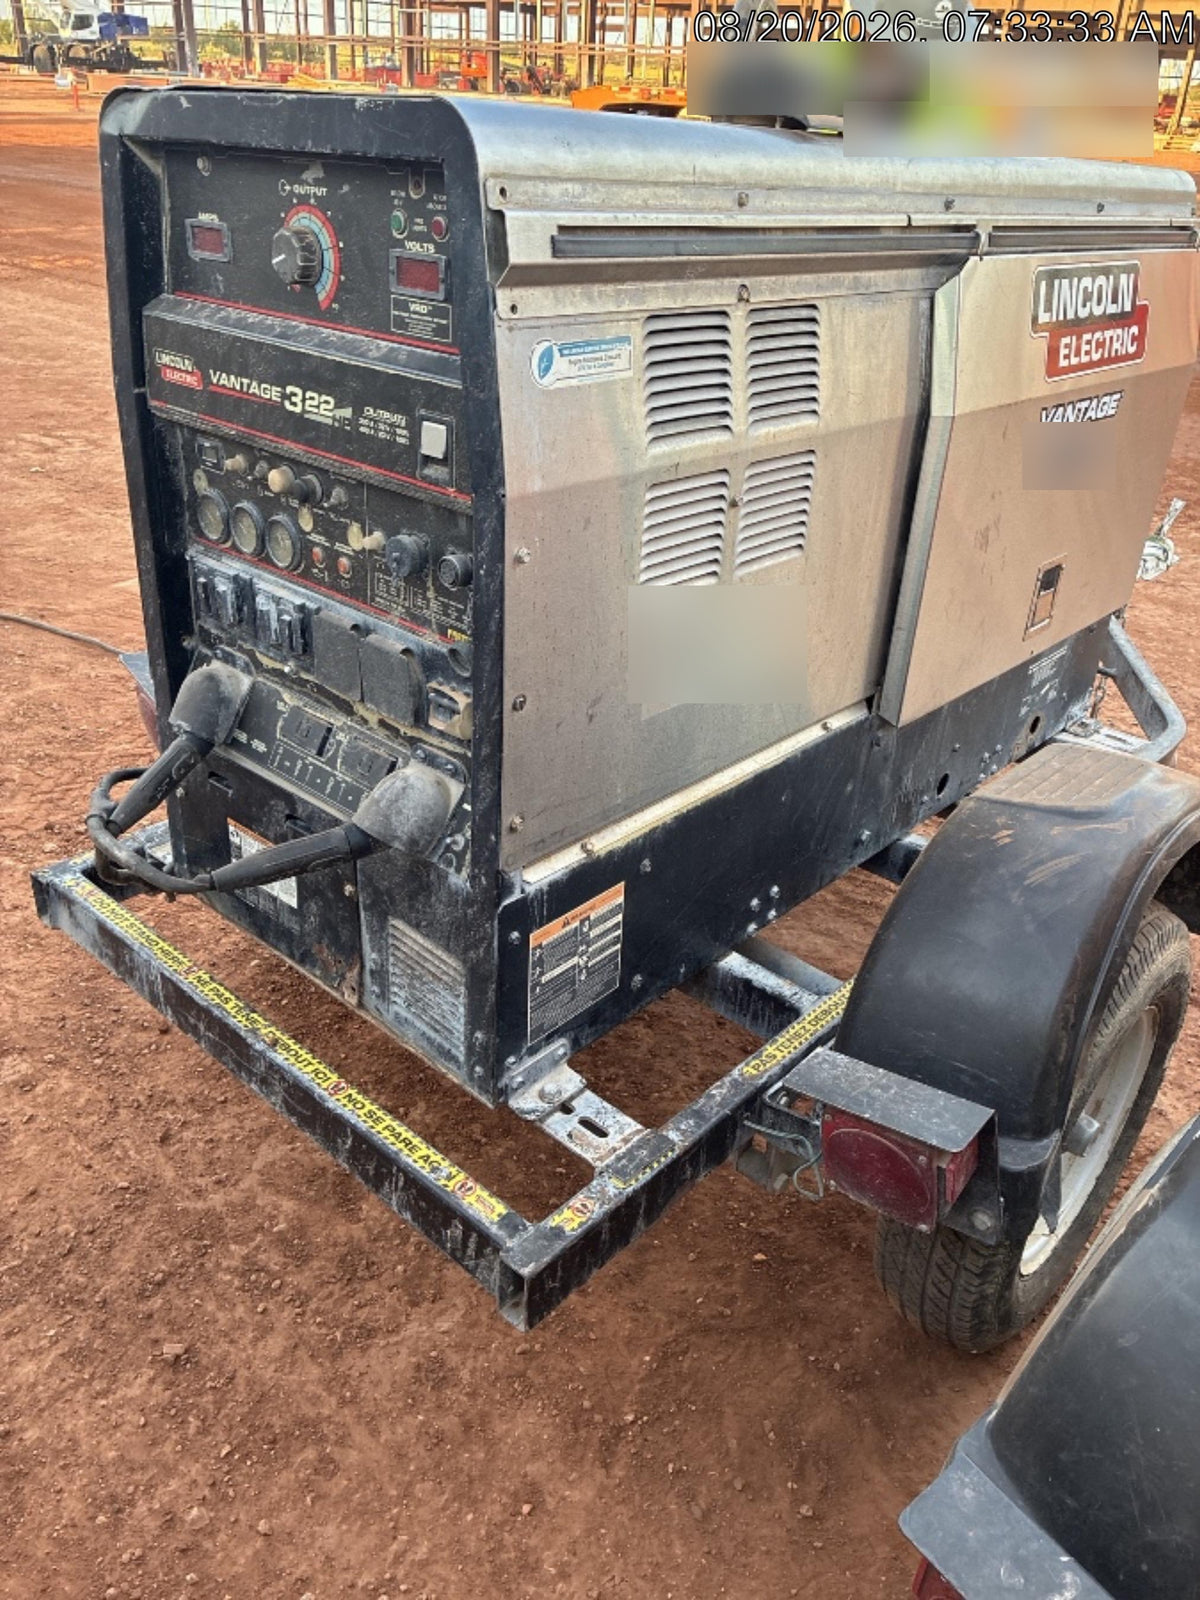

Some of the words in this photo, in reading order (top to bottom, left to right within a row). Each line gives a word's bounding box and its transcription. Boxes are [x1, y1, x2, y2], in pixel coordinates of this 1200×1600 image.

[293, 184, 328, 196] OUTPUT
[198, 212, 219, 222] AMPS
[404, 240, 435, 253] VOLTS
[1037, 273, 1135, 324] LINCOLN
[155, 351, 193, 372] LINCOLN
[1058, 325, 1139, 368] ELECTRIC
[166, 369, 198, 386] ELECTRIC
[209, 369, 282, 402] VANTAGE
[284, 385, 335, 417] 322
[1040, 391, 1123, 422] VANTAGE
[94, 897, 110, 909] DO
[127, 921, 160, 948] STAND
[157, 946, 185, 967] HERE
[194, 974, 211, 988] NE
[209, 986, 232, 1006] PAS
[311, 1067, 332, 1084] ICI
[751, 1051, 777, 1073] PAS
[343, 1092, 366, 1110] NO
[363, 1108, 385, 1126] SE
[382, 1124, 422, 1154] PARE
